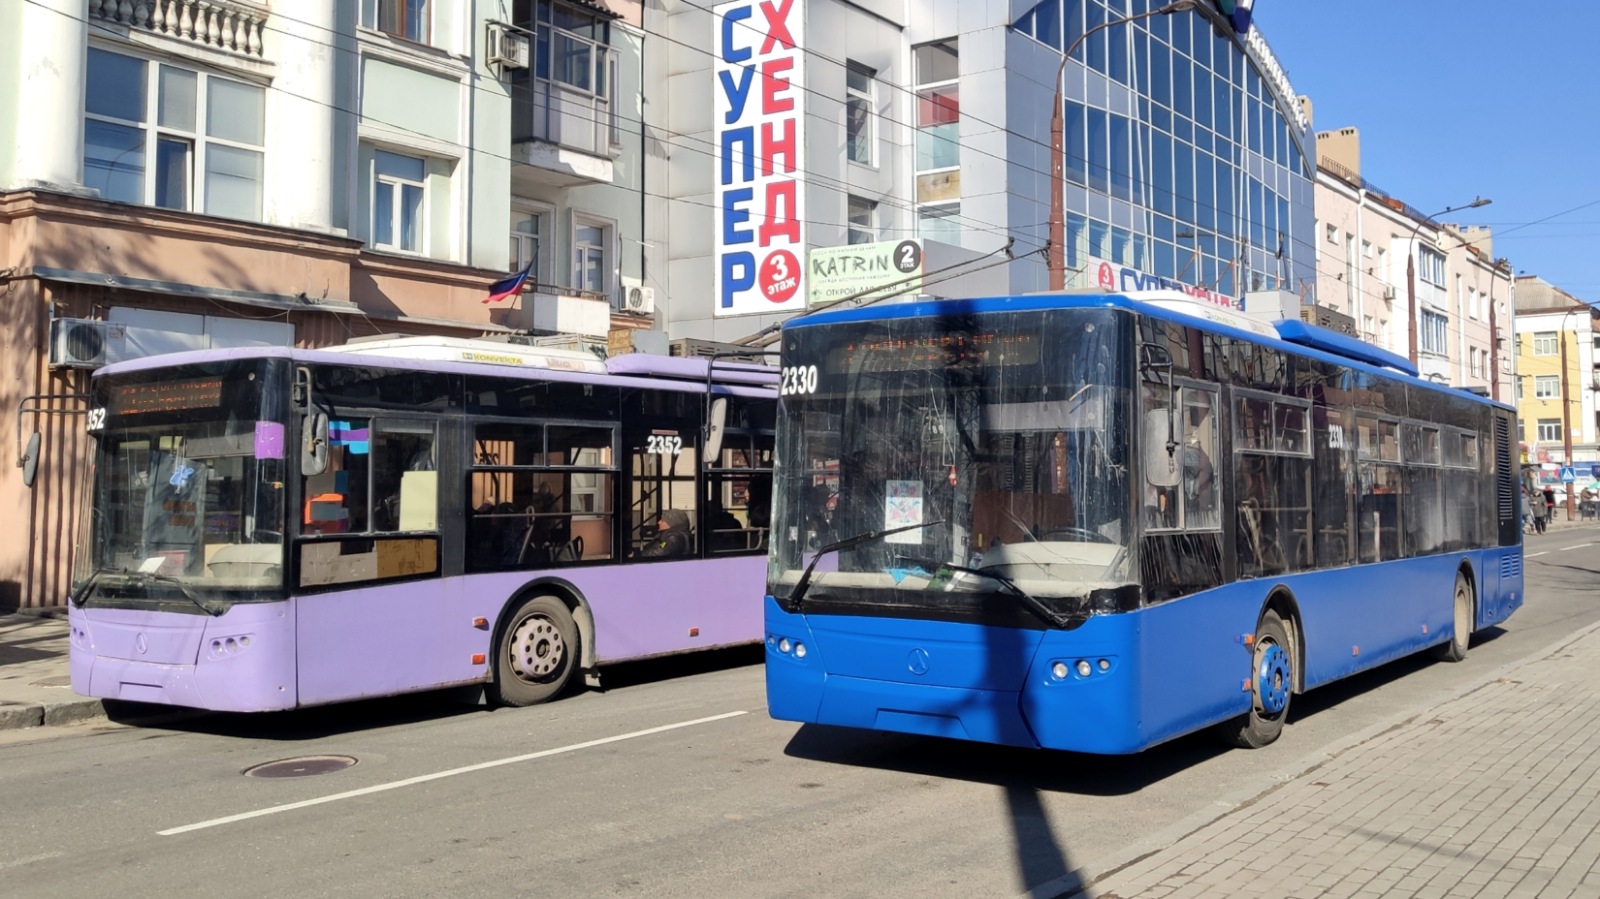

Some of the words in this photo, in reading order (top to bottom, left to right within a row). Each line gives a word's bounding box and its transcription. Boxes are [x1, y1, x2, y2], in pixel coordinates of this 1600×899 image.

[759, 0, 801, 247] ХЕНД
[718, 5, 756, 308] СУПЕР
[901, 245, 914, 263] 2
[770, 254, 788, 281] 3
[812, 255, 888, 277] KATRIN
[1103, 266, 1109, 283] 3
[767, 277, 796, 295] этаж
[826, 285, 857, 296] ОТКРОЙ
[781, 365, 817, 395] 2330
[647, 435, 682, 455] 2352
[1328, 423, 1343, 449] 2330
